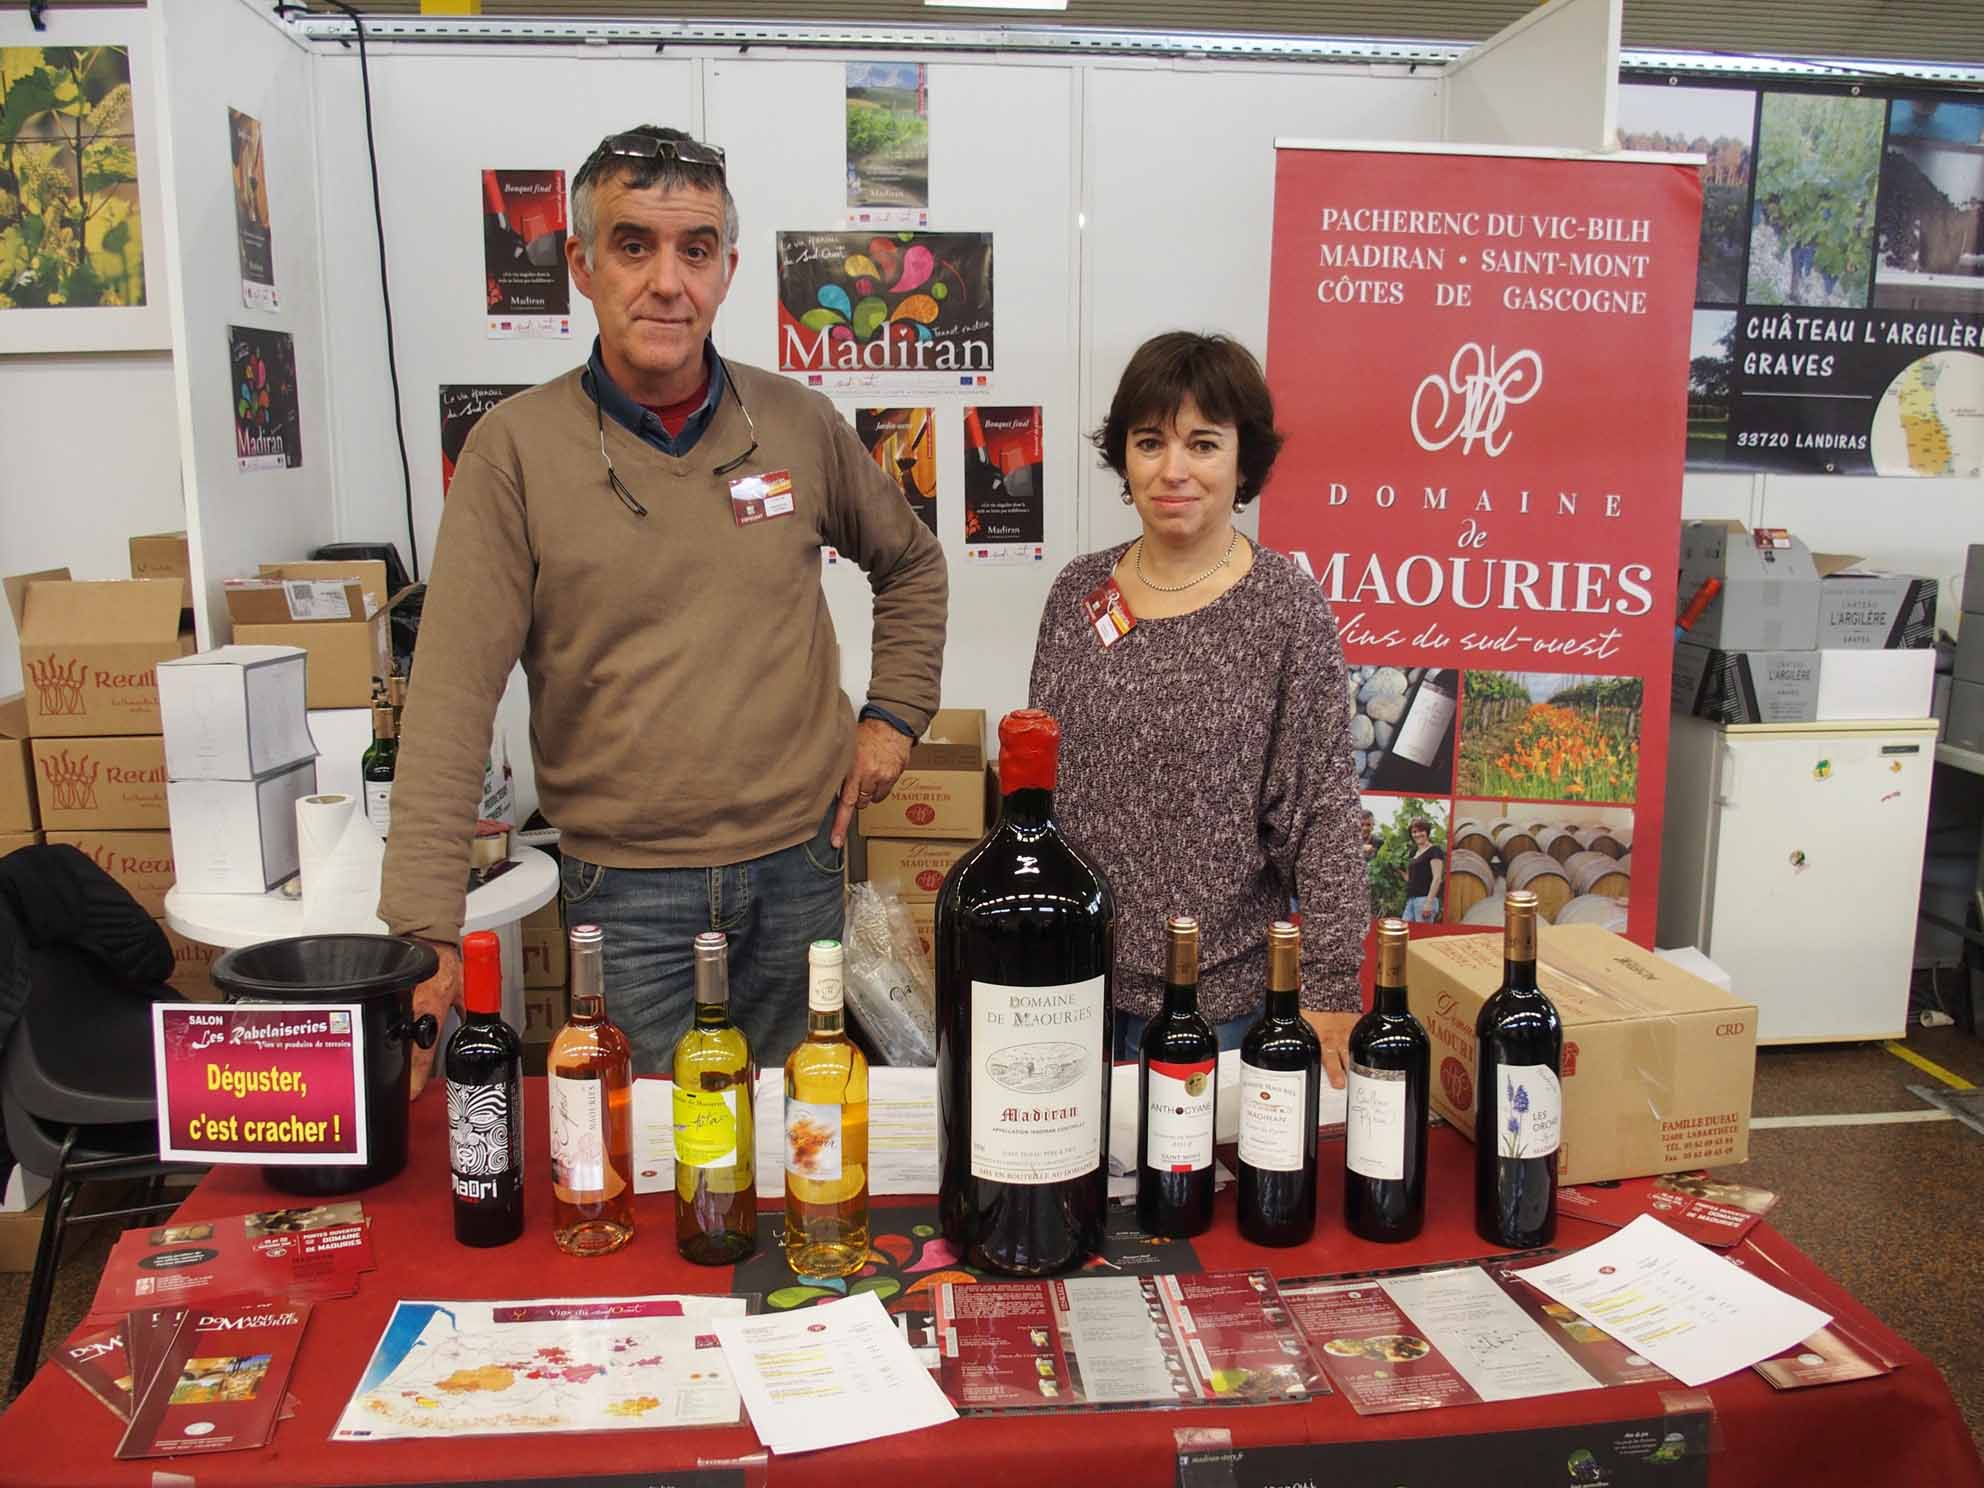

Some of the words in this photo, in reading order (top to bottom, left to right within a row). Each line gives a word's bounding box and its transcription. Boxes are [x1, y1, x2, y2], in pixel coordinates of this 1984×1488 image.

[1321, 208, 1480, 238] PACHERENC
[1487, 215, 1524, 238] DU
[1533, 216, 1650, 242] VIC-BILH
[1319, 245, 1445, 270] MADIRAN
[1481, 249, 1650, 278] SAINT-MONT
[511, 295, 545, 305] Madiran
[1317, 275, 1404, 305] CÔTES
[1435, 284, 1472, 306] DE
[1503, 286, 1648, 315] GASCOGNE
[1746, 312, 1855, 342] CHÂTEAU
[781, 321, 993, 371] Madiran
[1744, 352, 1836, 377] GRAVES
[985, 419, 1013, 430] Bouquet
[1013, 418, 1030, 430] final
[238, 426, 284, 457] Madiran
[1737, 432, 1790, 448] 33720
[1795, 433, 1868, 450] LANDIRAS
[1329, 483, 1622, 518] DOMAINE
[987, 525, 1020, 536] Madiran
[1457, 518, 1489, 549] de
[1289, 550, 1653, 616] MAOURIES
[1411, 622, 1450, 649] du
[1459, 626, 1623, 660] sud-ouest
[892, 793, 951, 801] MAOURIES
[1009, 993, 1077, 1009] DOMAINE
[189, 1015, 223, 1026] SALON
[987, 1010, 1005, 1026] DE
[1013, 1006, 1093, 1027] MAOURIES
[192, 1029, 224, 1050] Les
[229, 1019, 328, 1046] Rabelaiseries
[1715, 1022, 1745, 1037] CRD
[207, 1063, 308, 1099] Déguster,
[1001, 1105, 1079, 1122] Madiran
[1532, 1110, 1547, 1121] LES
[189, 1113, 239, 1142] c'est
[244, 1114, 328, 1143] cracher
[333, 1114, 342, 1143] !
[318, 1239, 362, 1252] MAOURIES
[322, 1232, 361, 1243] DOMAINE
